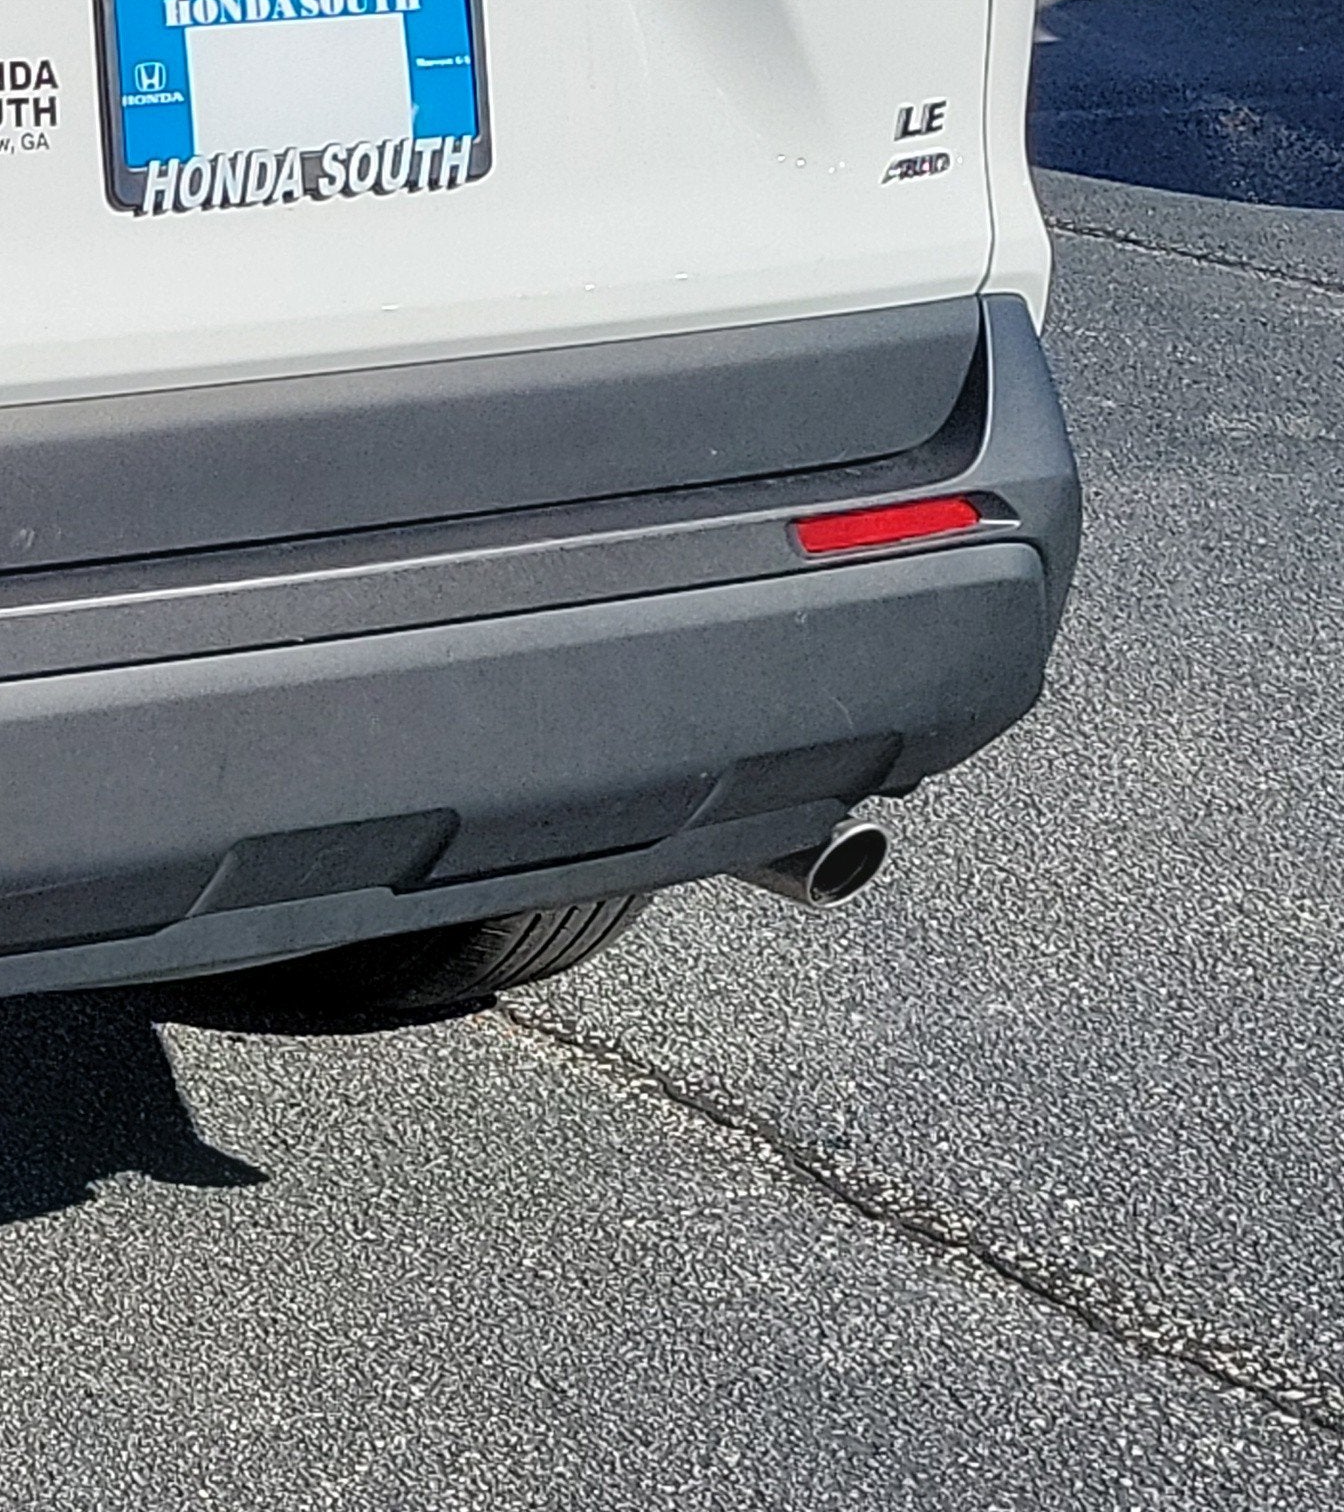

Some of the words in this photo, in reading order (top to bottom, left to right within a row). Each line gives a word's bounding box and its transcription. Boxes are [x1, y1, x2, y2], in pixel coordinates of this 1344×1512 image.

[122, 91, 185, 107] HONDA
[893, 100, 947, 142] LE
[20, 132, 50, 151] GA
[143, 148, 303, 213] HONDA
[317, 135, 472, 198] SOUTH
